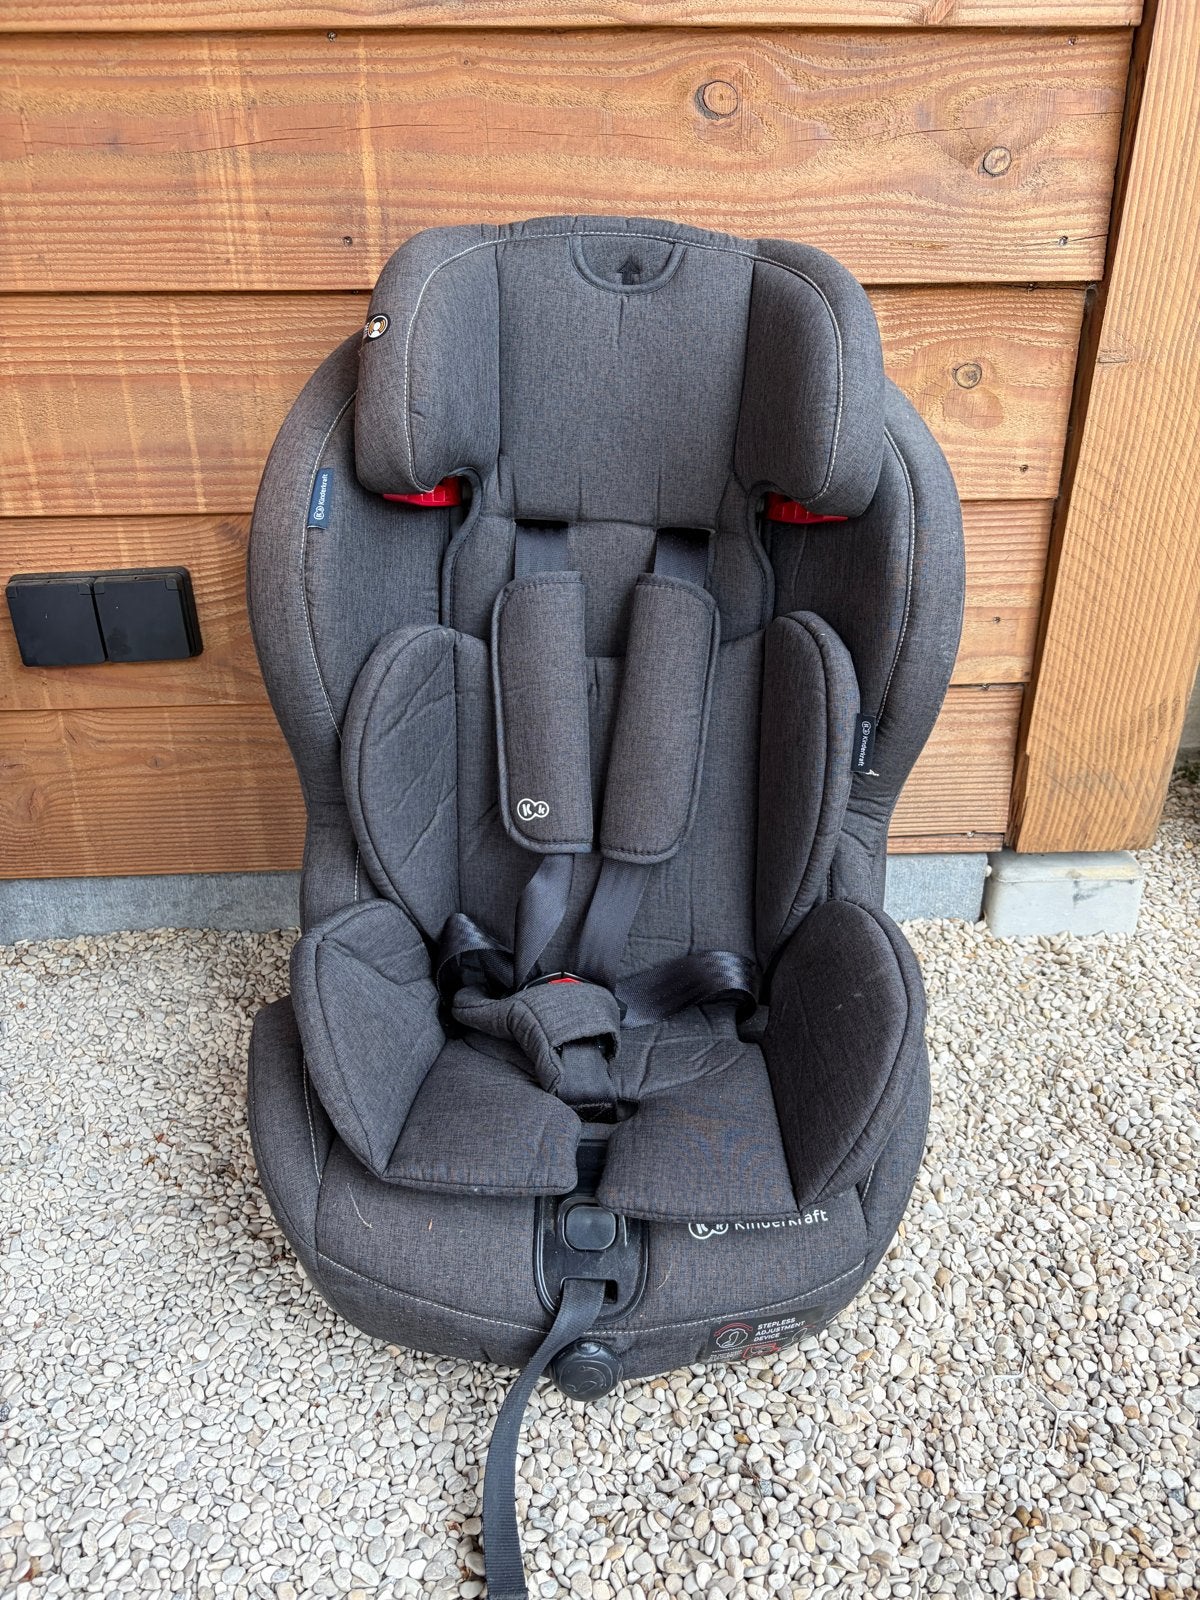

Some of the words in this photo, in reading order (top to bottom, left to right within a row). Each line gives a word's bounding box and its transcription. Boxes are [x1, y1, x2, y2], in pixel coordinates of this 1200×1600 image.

[318, 473, 328, 505] Kinderkraft
[858, 736, 868, 767] Kinderkraft
[755, 1320, 806, 1336] ADJUSTMENT
[757, 1317, 796, 1330] STEPLESS
[753, 1332, 781, 1342] DEVICE
